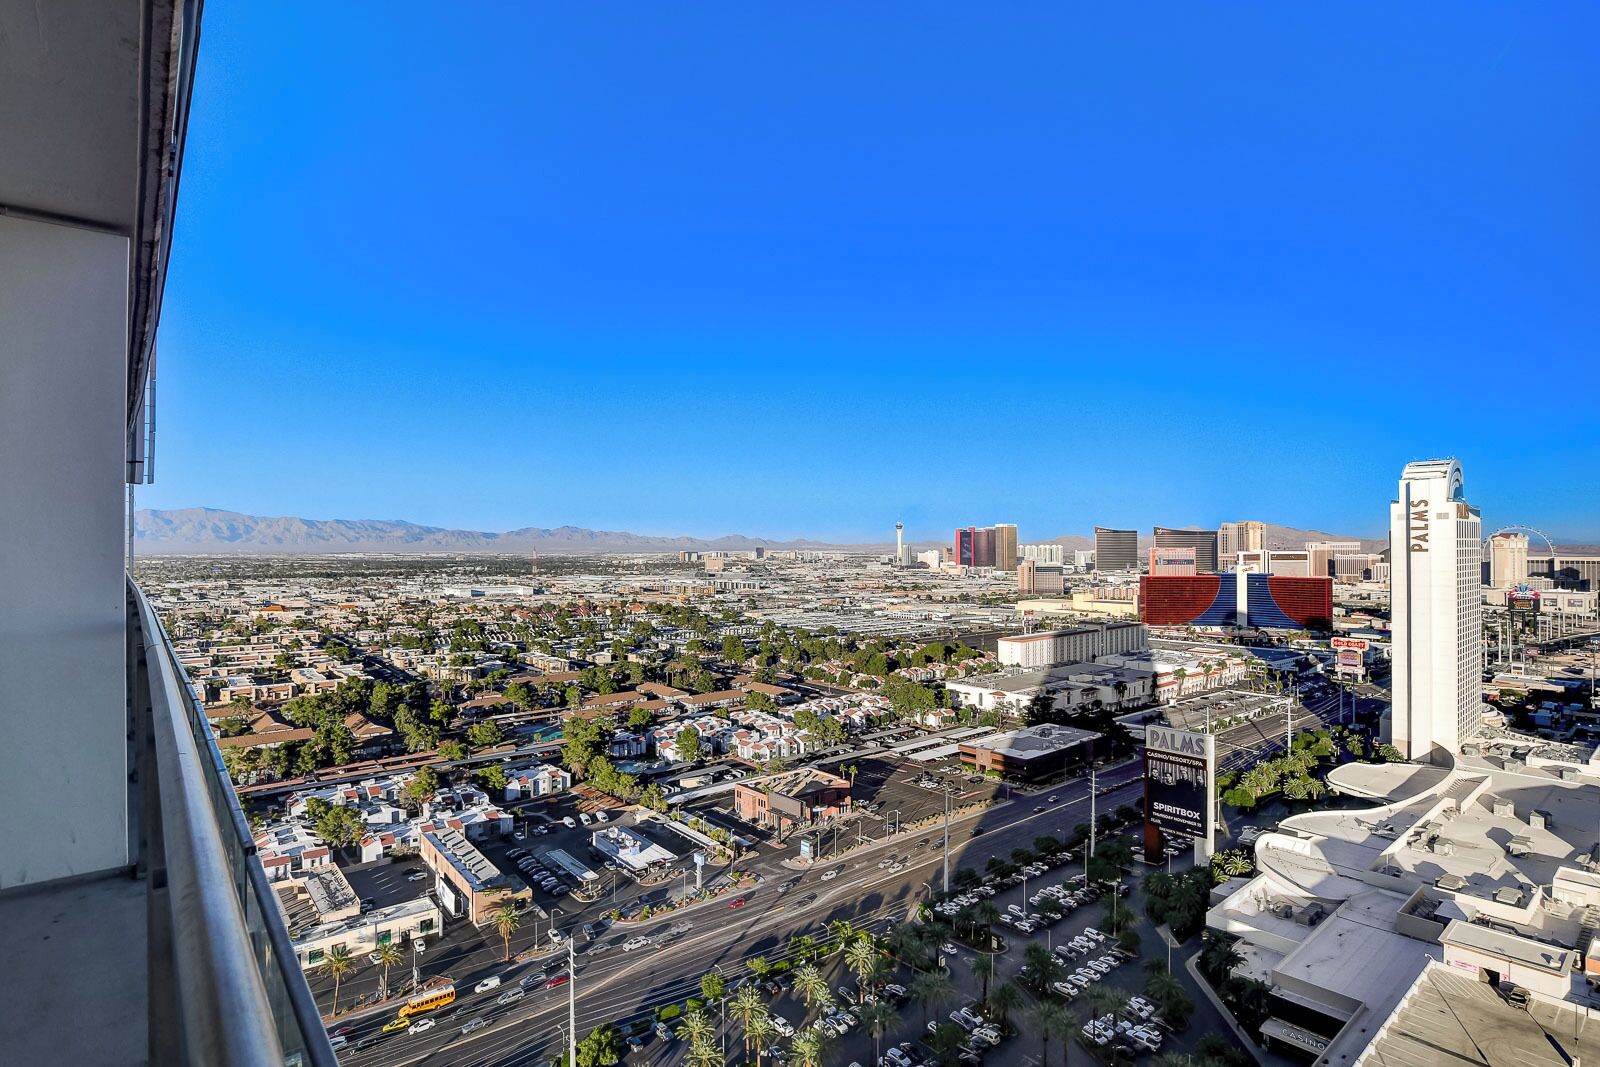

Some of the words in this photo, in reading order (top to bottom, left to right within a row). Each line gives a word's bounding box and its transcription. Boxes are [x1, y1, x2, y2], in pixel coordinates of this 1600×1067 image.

[1410, 500, 1428, 552] PALMS
[1150, 730, 1204, 756] PALMS
[1153, 802, 1200, 820] SPIRITBOX
[1173, 816, 1197, 826] NOVEMBER
[1282, 1028, 1325, 1050] CASINO
